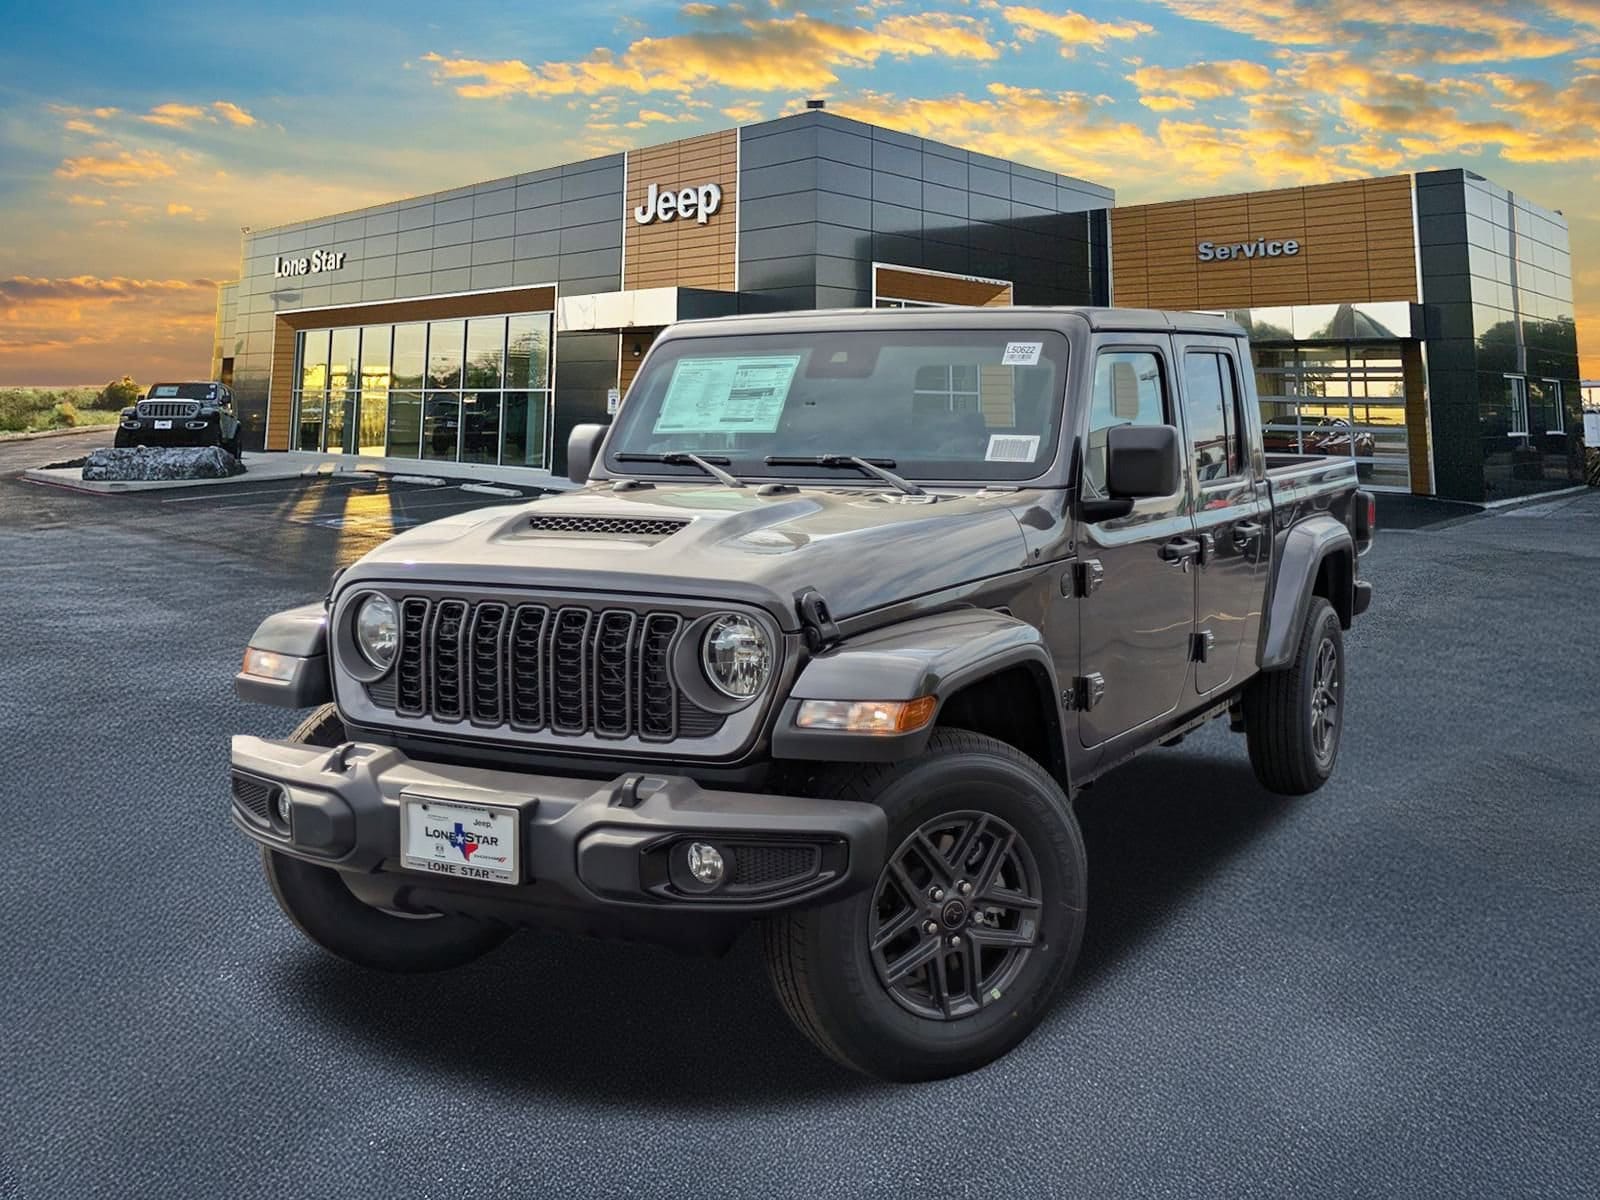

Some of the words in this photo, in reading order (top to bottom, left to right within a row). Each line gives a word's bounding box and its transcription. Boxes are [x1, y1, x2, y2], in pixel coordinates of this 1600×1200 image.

[634, 183, 721, 225] Jeep
[1198, 237, 1299, 261] Service
[274, 256, 309, 278] Lone
[312, 249, 345, 273] Star
[425, 826, 455, 841] LONE
[465, 832, 498, 847] STAR
[427, 861, 456, 874] LONE
[461, 866, 489, 879] STAR
